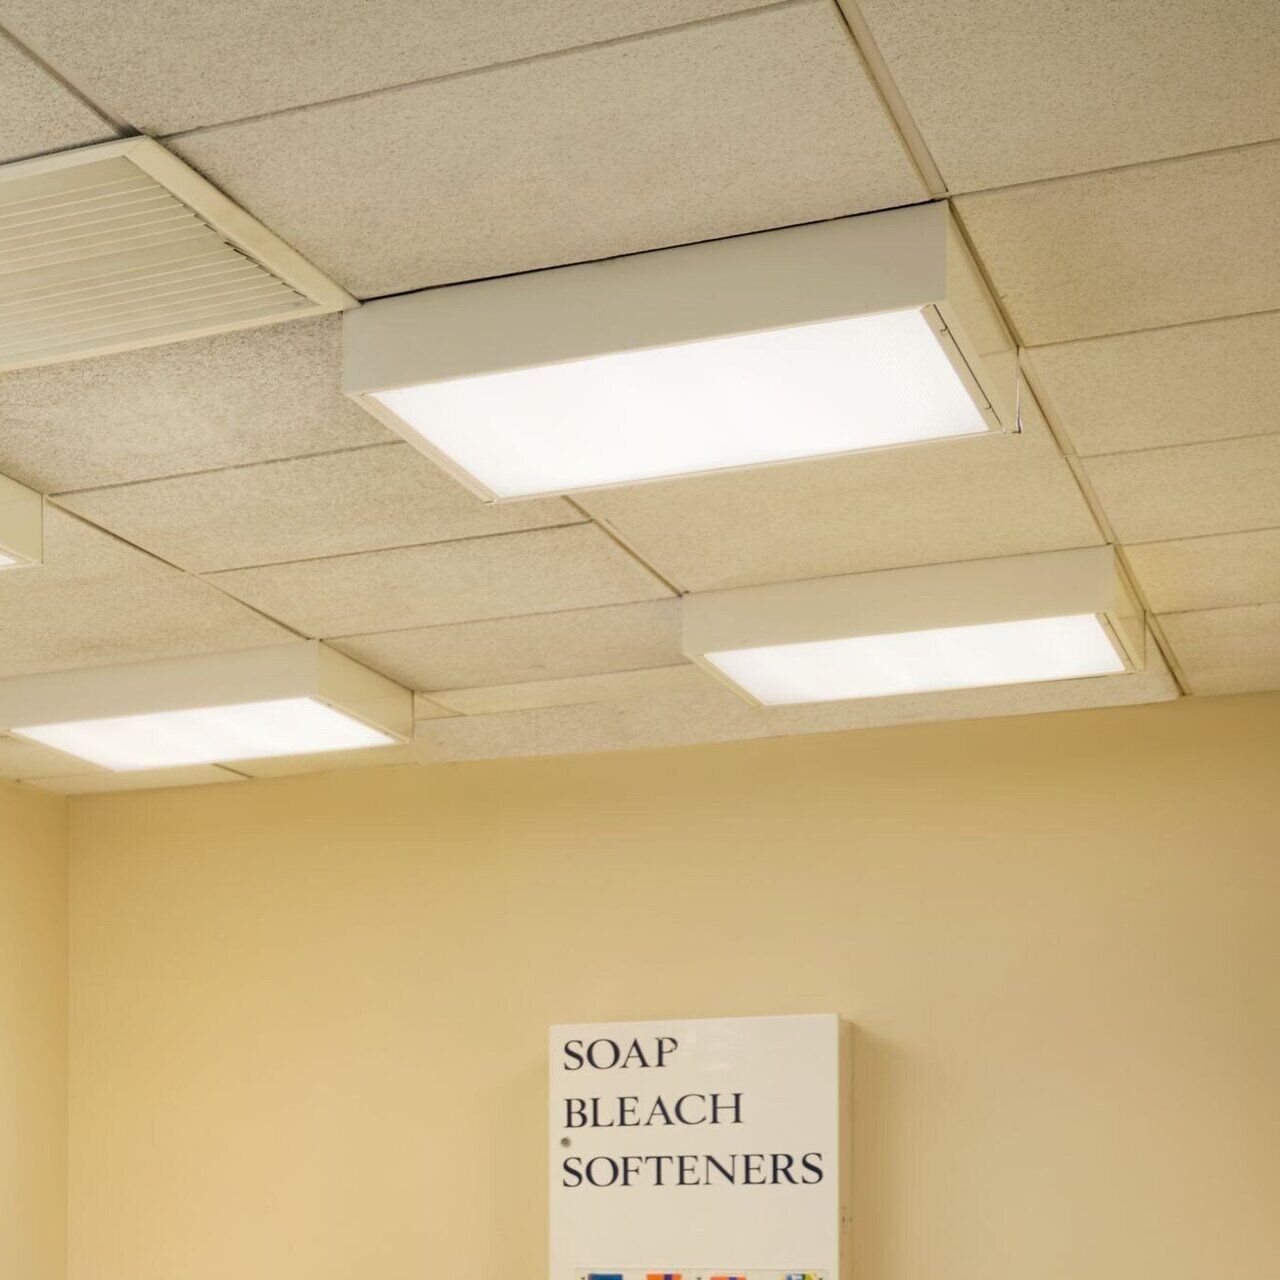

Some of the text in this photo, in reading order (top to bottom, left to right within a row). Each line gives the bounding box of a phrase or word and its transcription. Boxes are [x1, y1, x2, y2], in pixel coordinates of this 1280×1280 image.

[564, 1037, 678, 1070] SOAP
[564, 1092, 745, 1128] BLEACH
[562, 1153, 824, 1188] SOFTENERS
